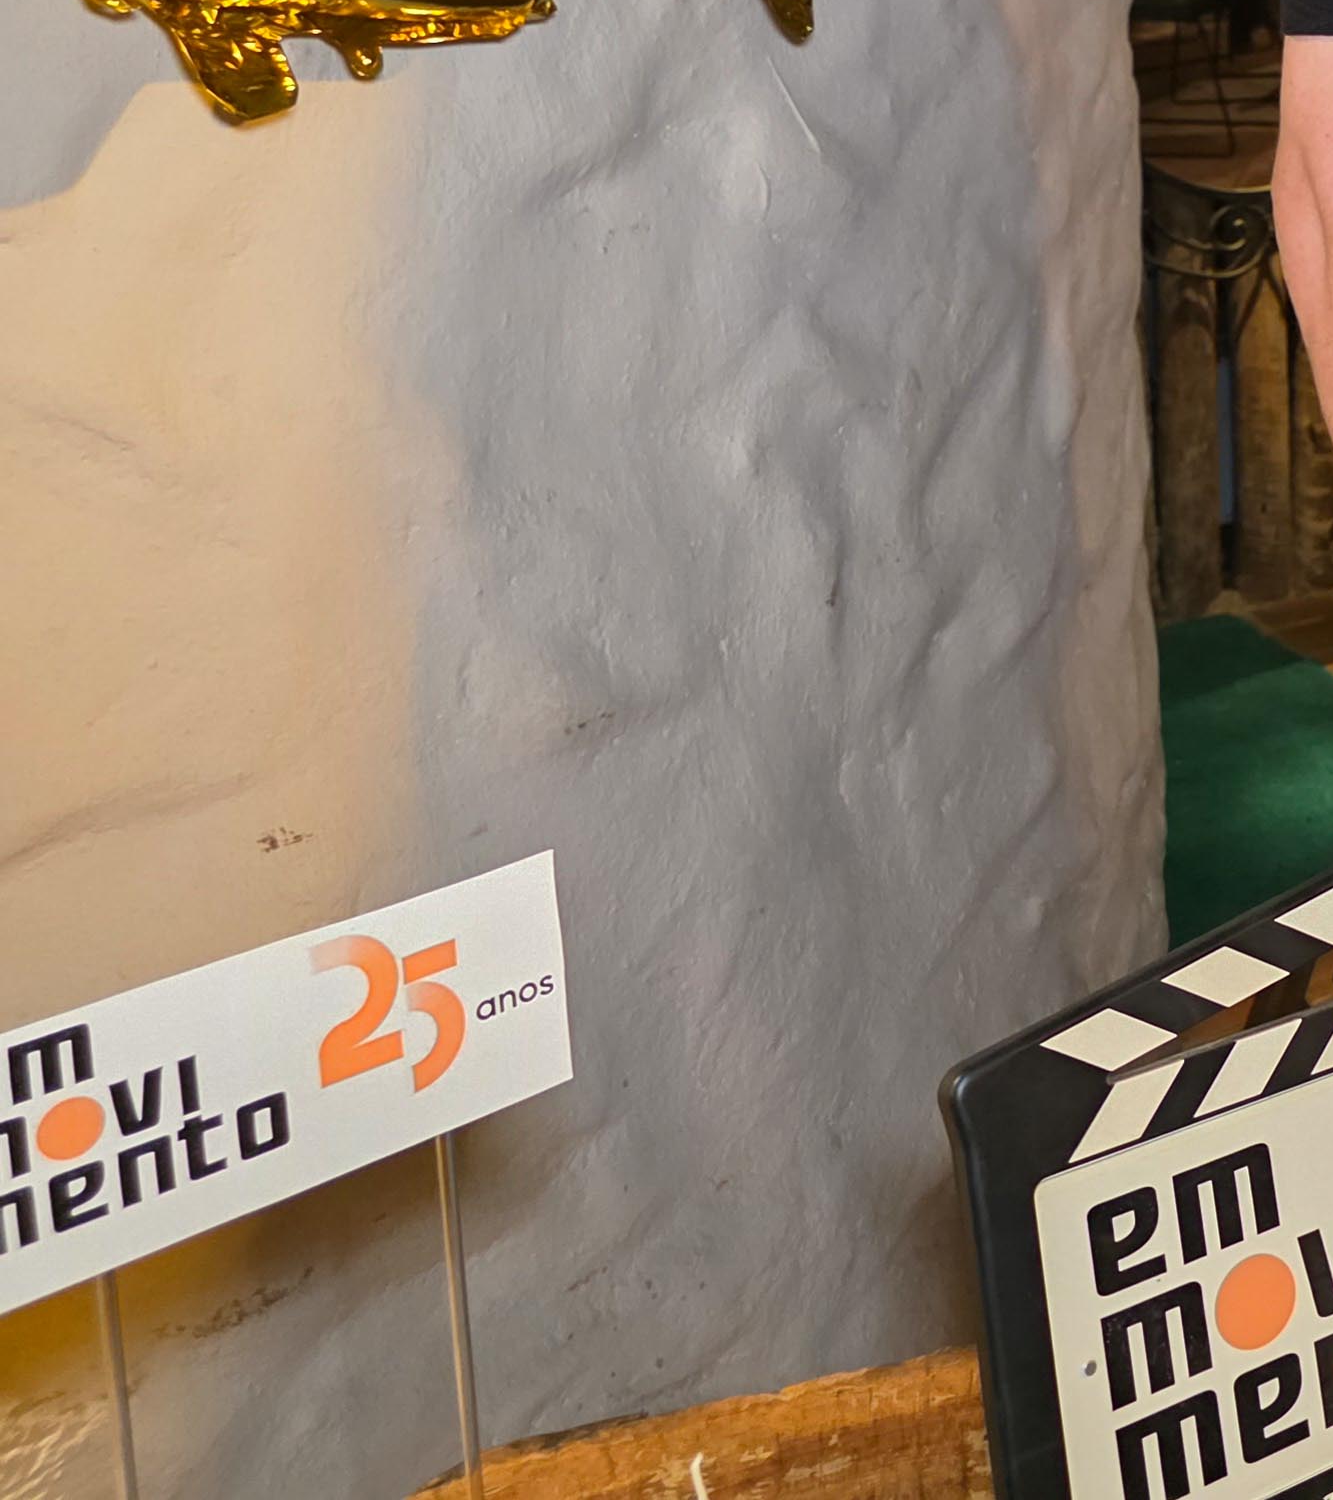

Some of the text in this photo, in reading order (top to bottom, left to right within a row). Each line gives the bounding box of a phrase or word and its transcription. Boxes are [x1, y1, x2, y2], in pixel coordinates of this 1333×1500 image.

[308, 934, 554, 1094] 25 anos
[1087, 1143, 1280, 1297] em
